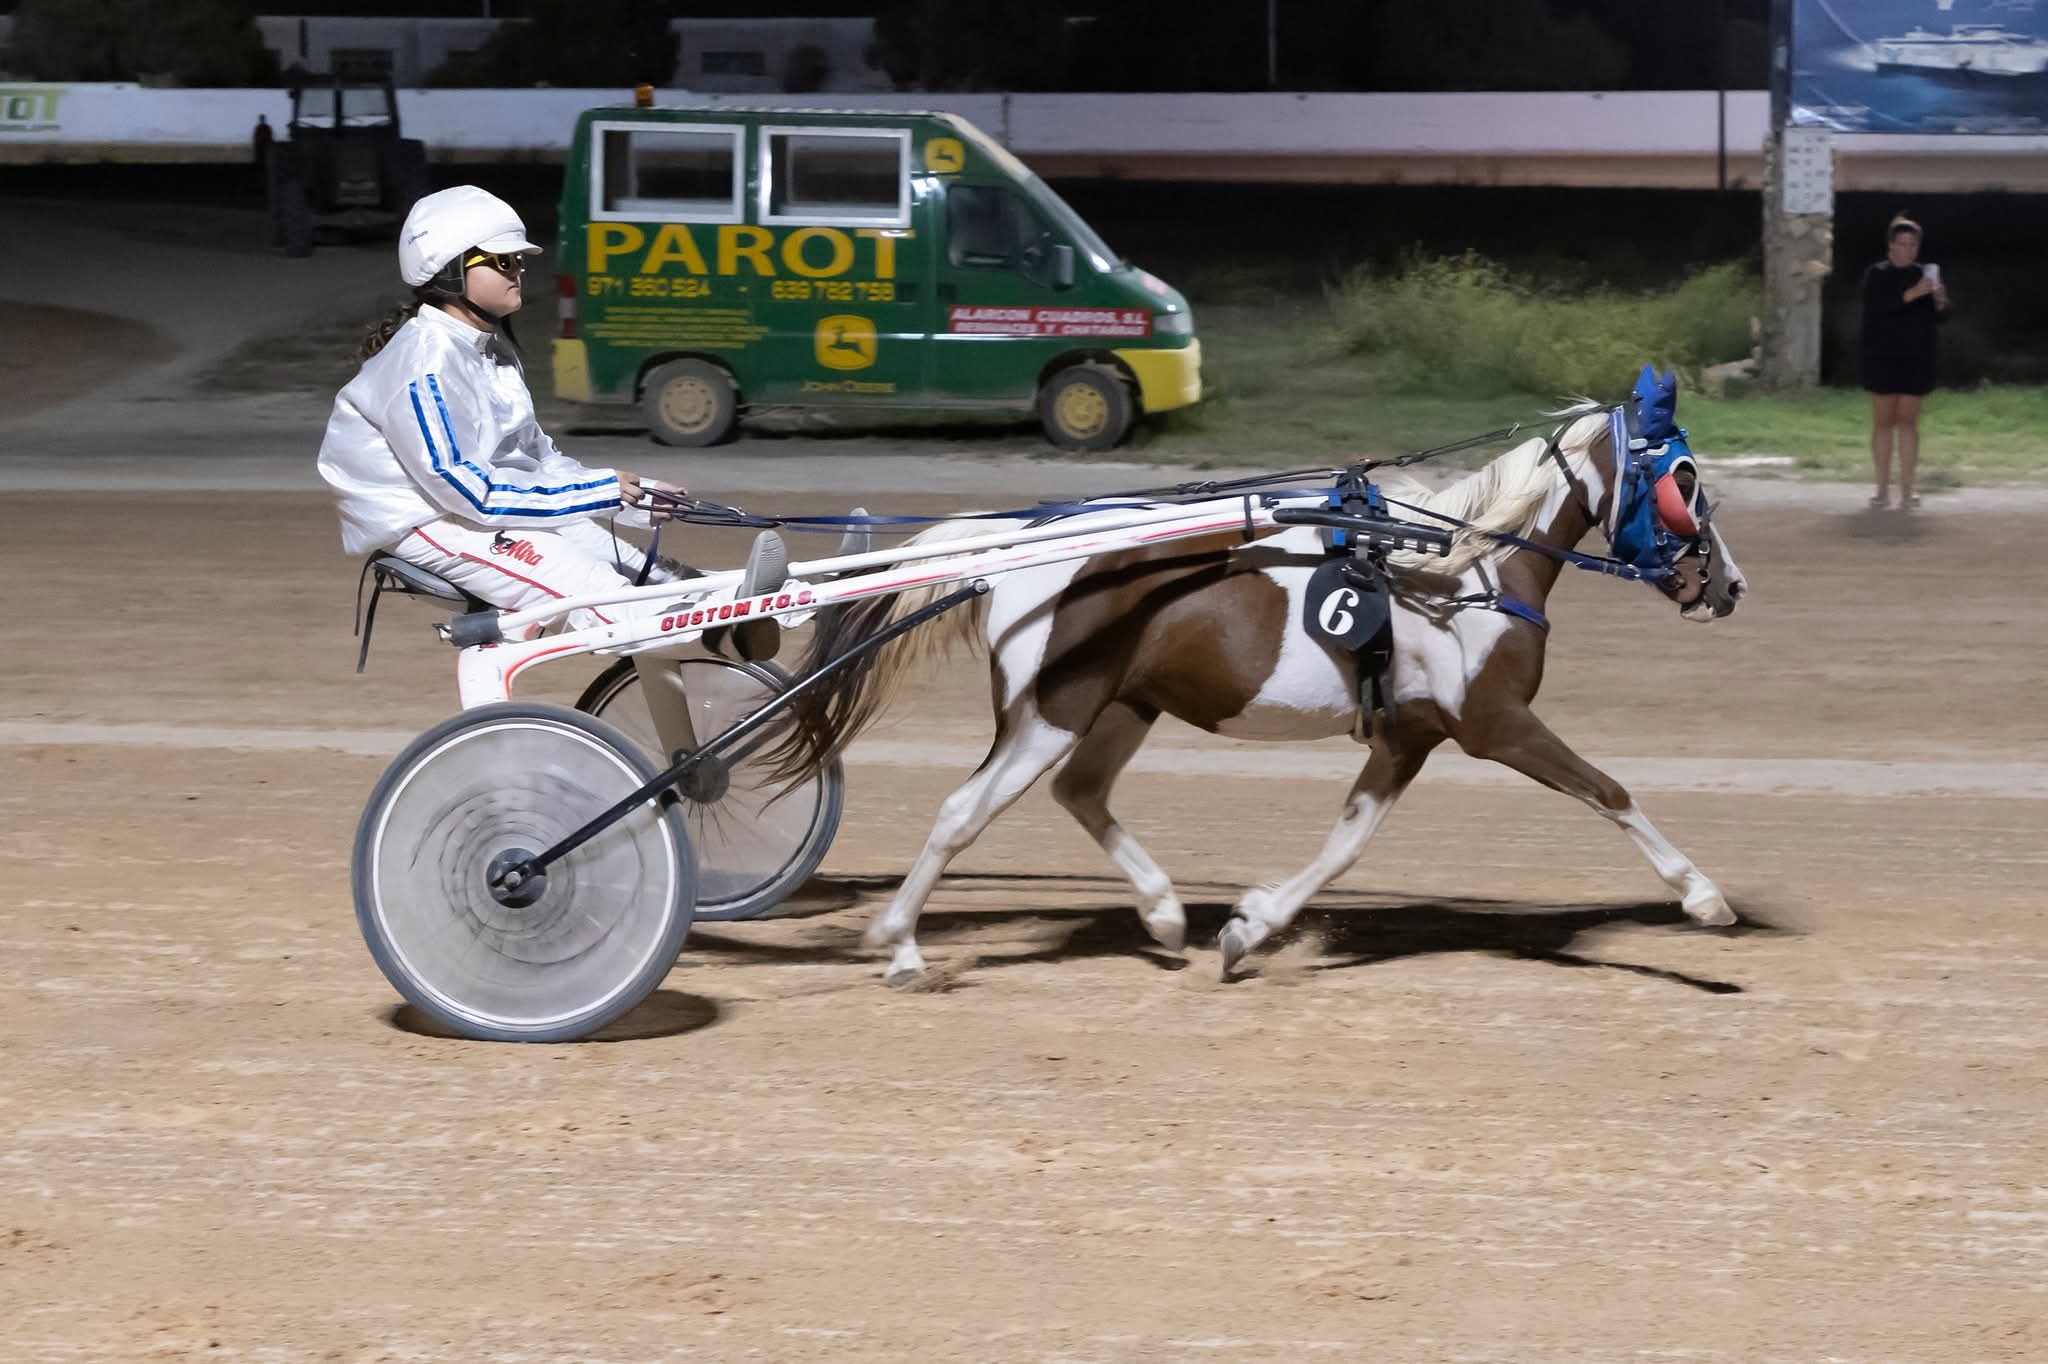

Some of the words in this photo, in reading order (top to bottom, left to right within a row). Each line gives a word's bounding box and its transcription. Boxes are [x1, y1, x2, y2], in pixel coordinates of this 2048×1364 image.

[587, 222, 915, 279] PAROT
[660, 601, 751, 632] CUSTOM
[1318, 587, 1360, 636] 6
